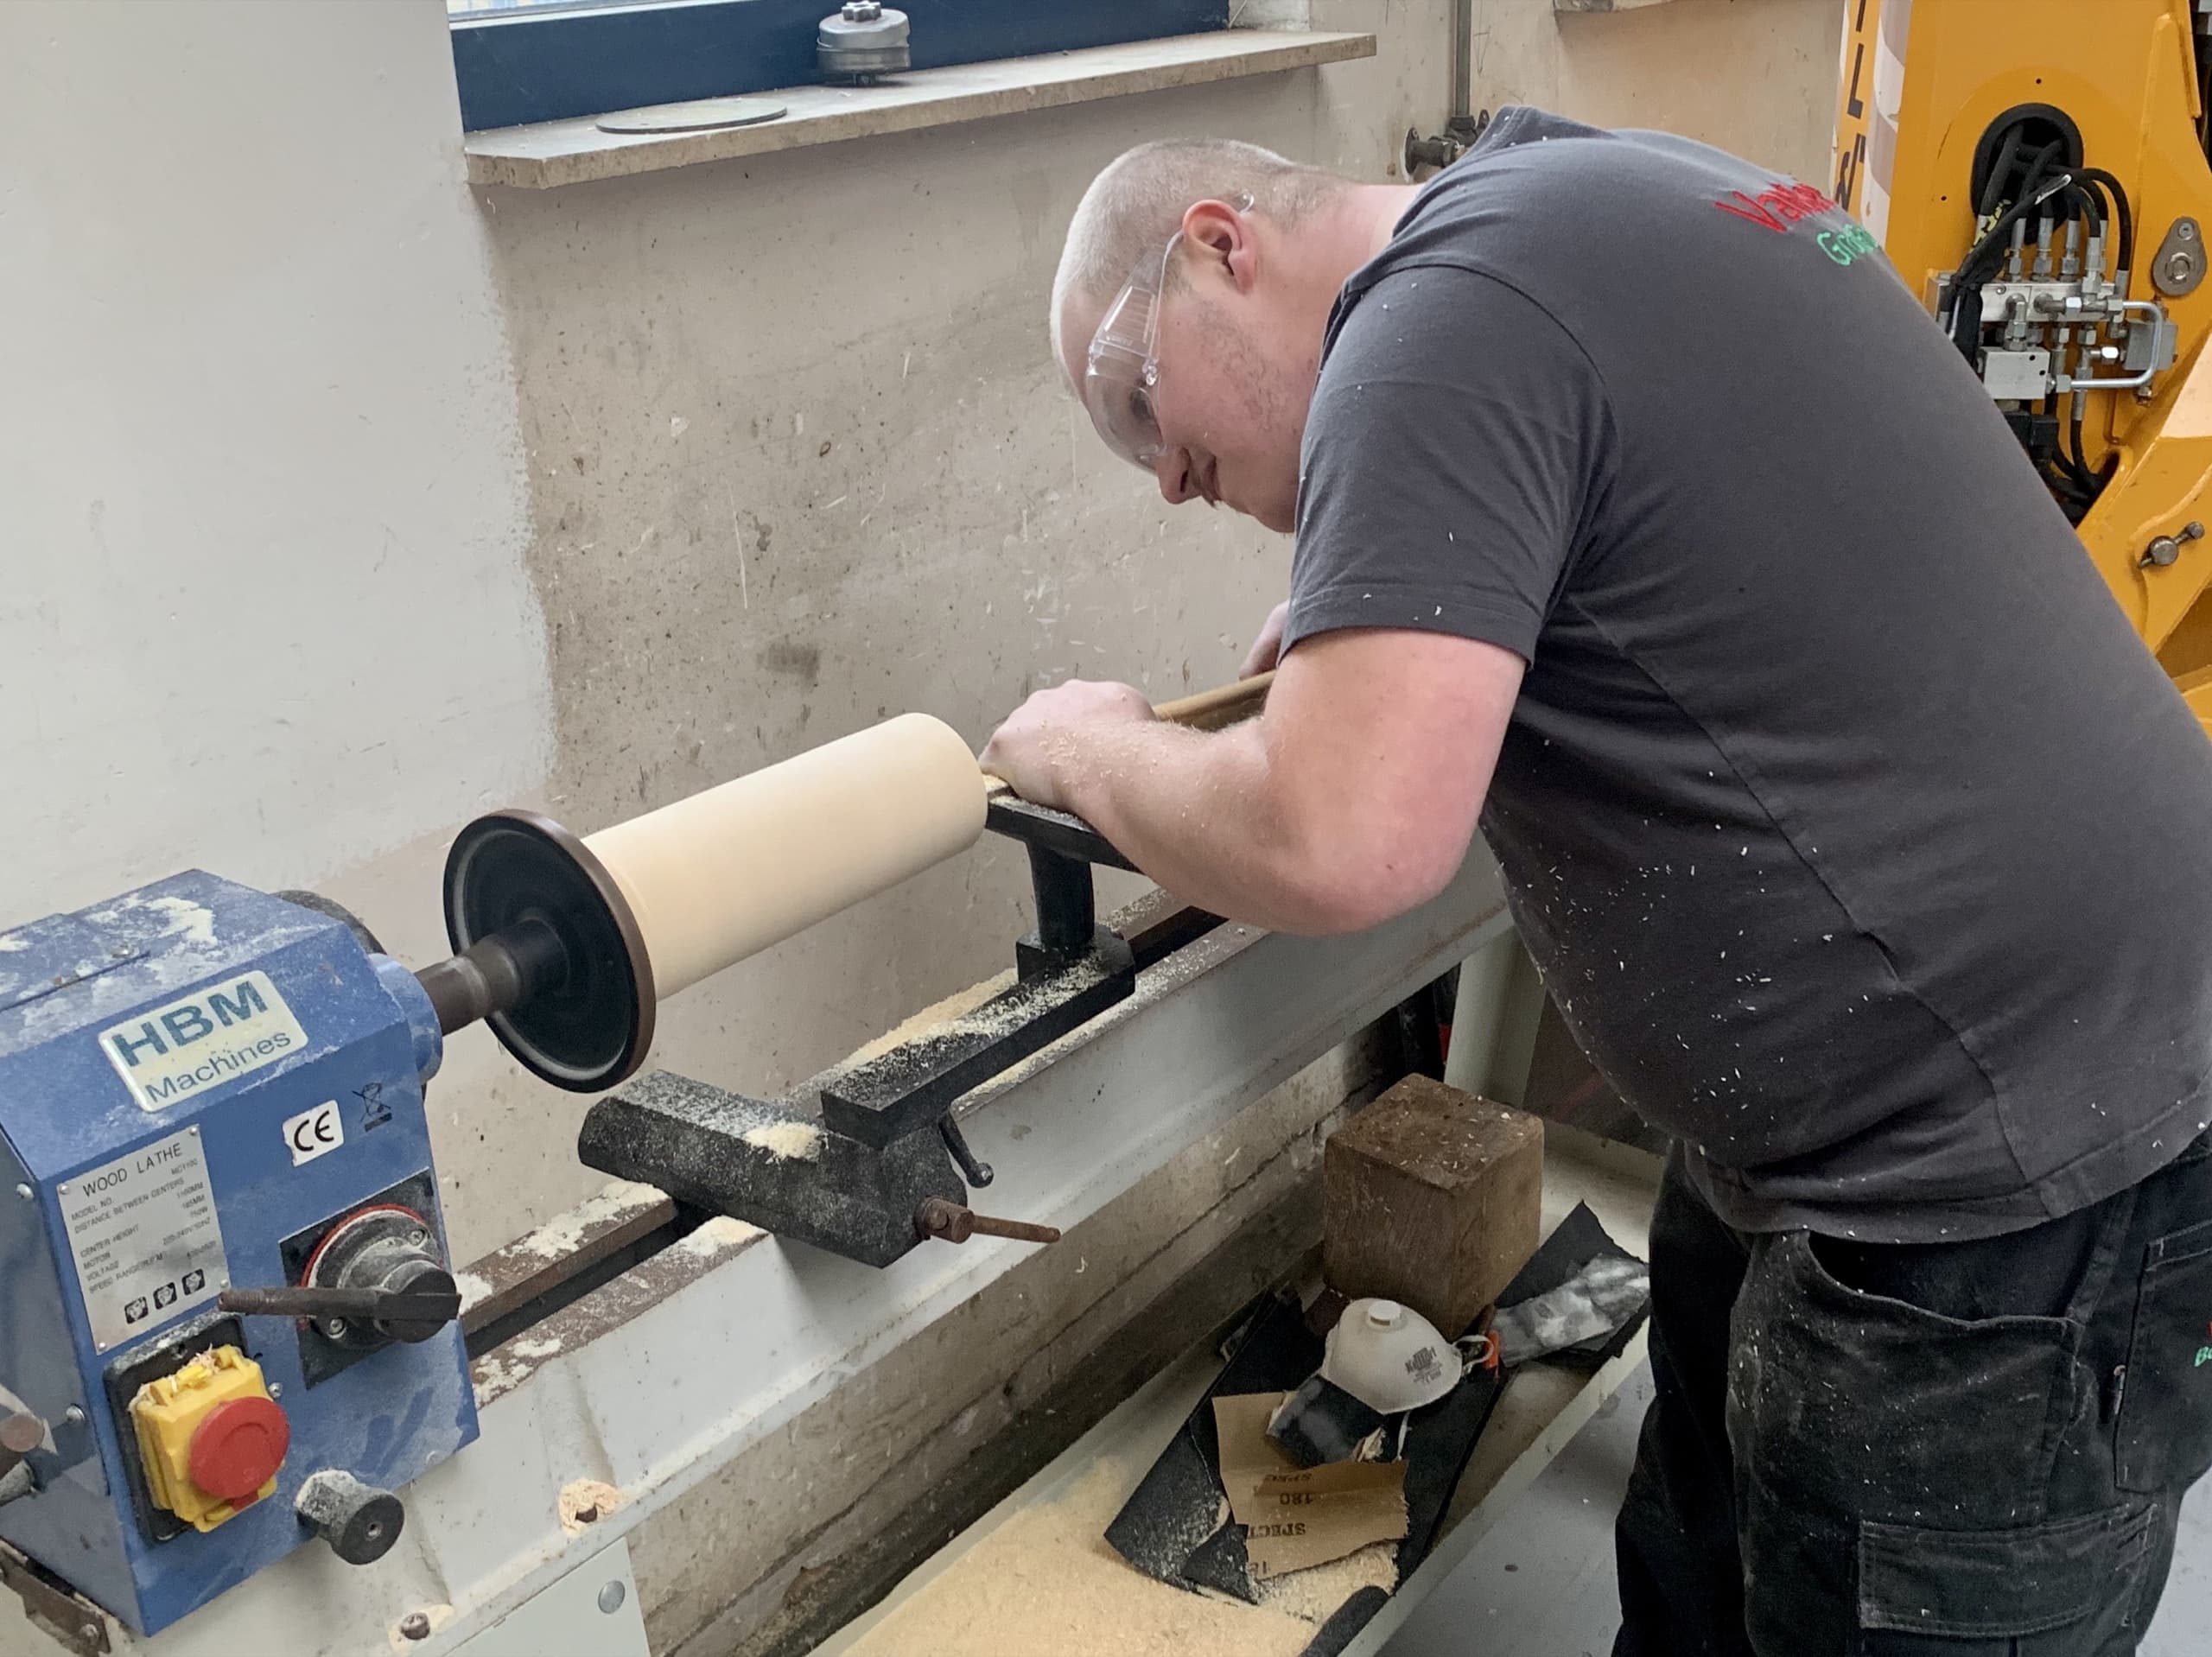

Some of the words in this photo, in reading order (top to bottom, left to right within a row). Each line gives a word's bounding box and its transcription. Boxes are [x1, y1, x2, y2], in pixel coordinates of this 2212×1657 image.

[111, 981, 269, 1067] HBM
[144, 1032, 291, 1102] Machines
[294, 1110, 334, 1152] CE
[83, 1168, 128, 1197] WOOD
[136, 1142, 182, 1173] LATHE
[74, 1210, 111, 1234] DISTANCE
[113, 1194, 149, 1215] BETWEEN
